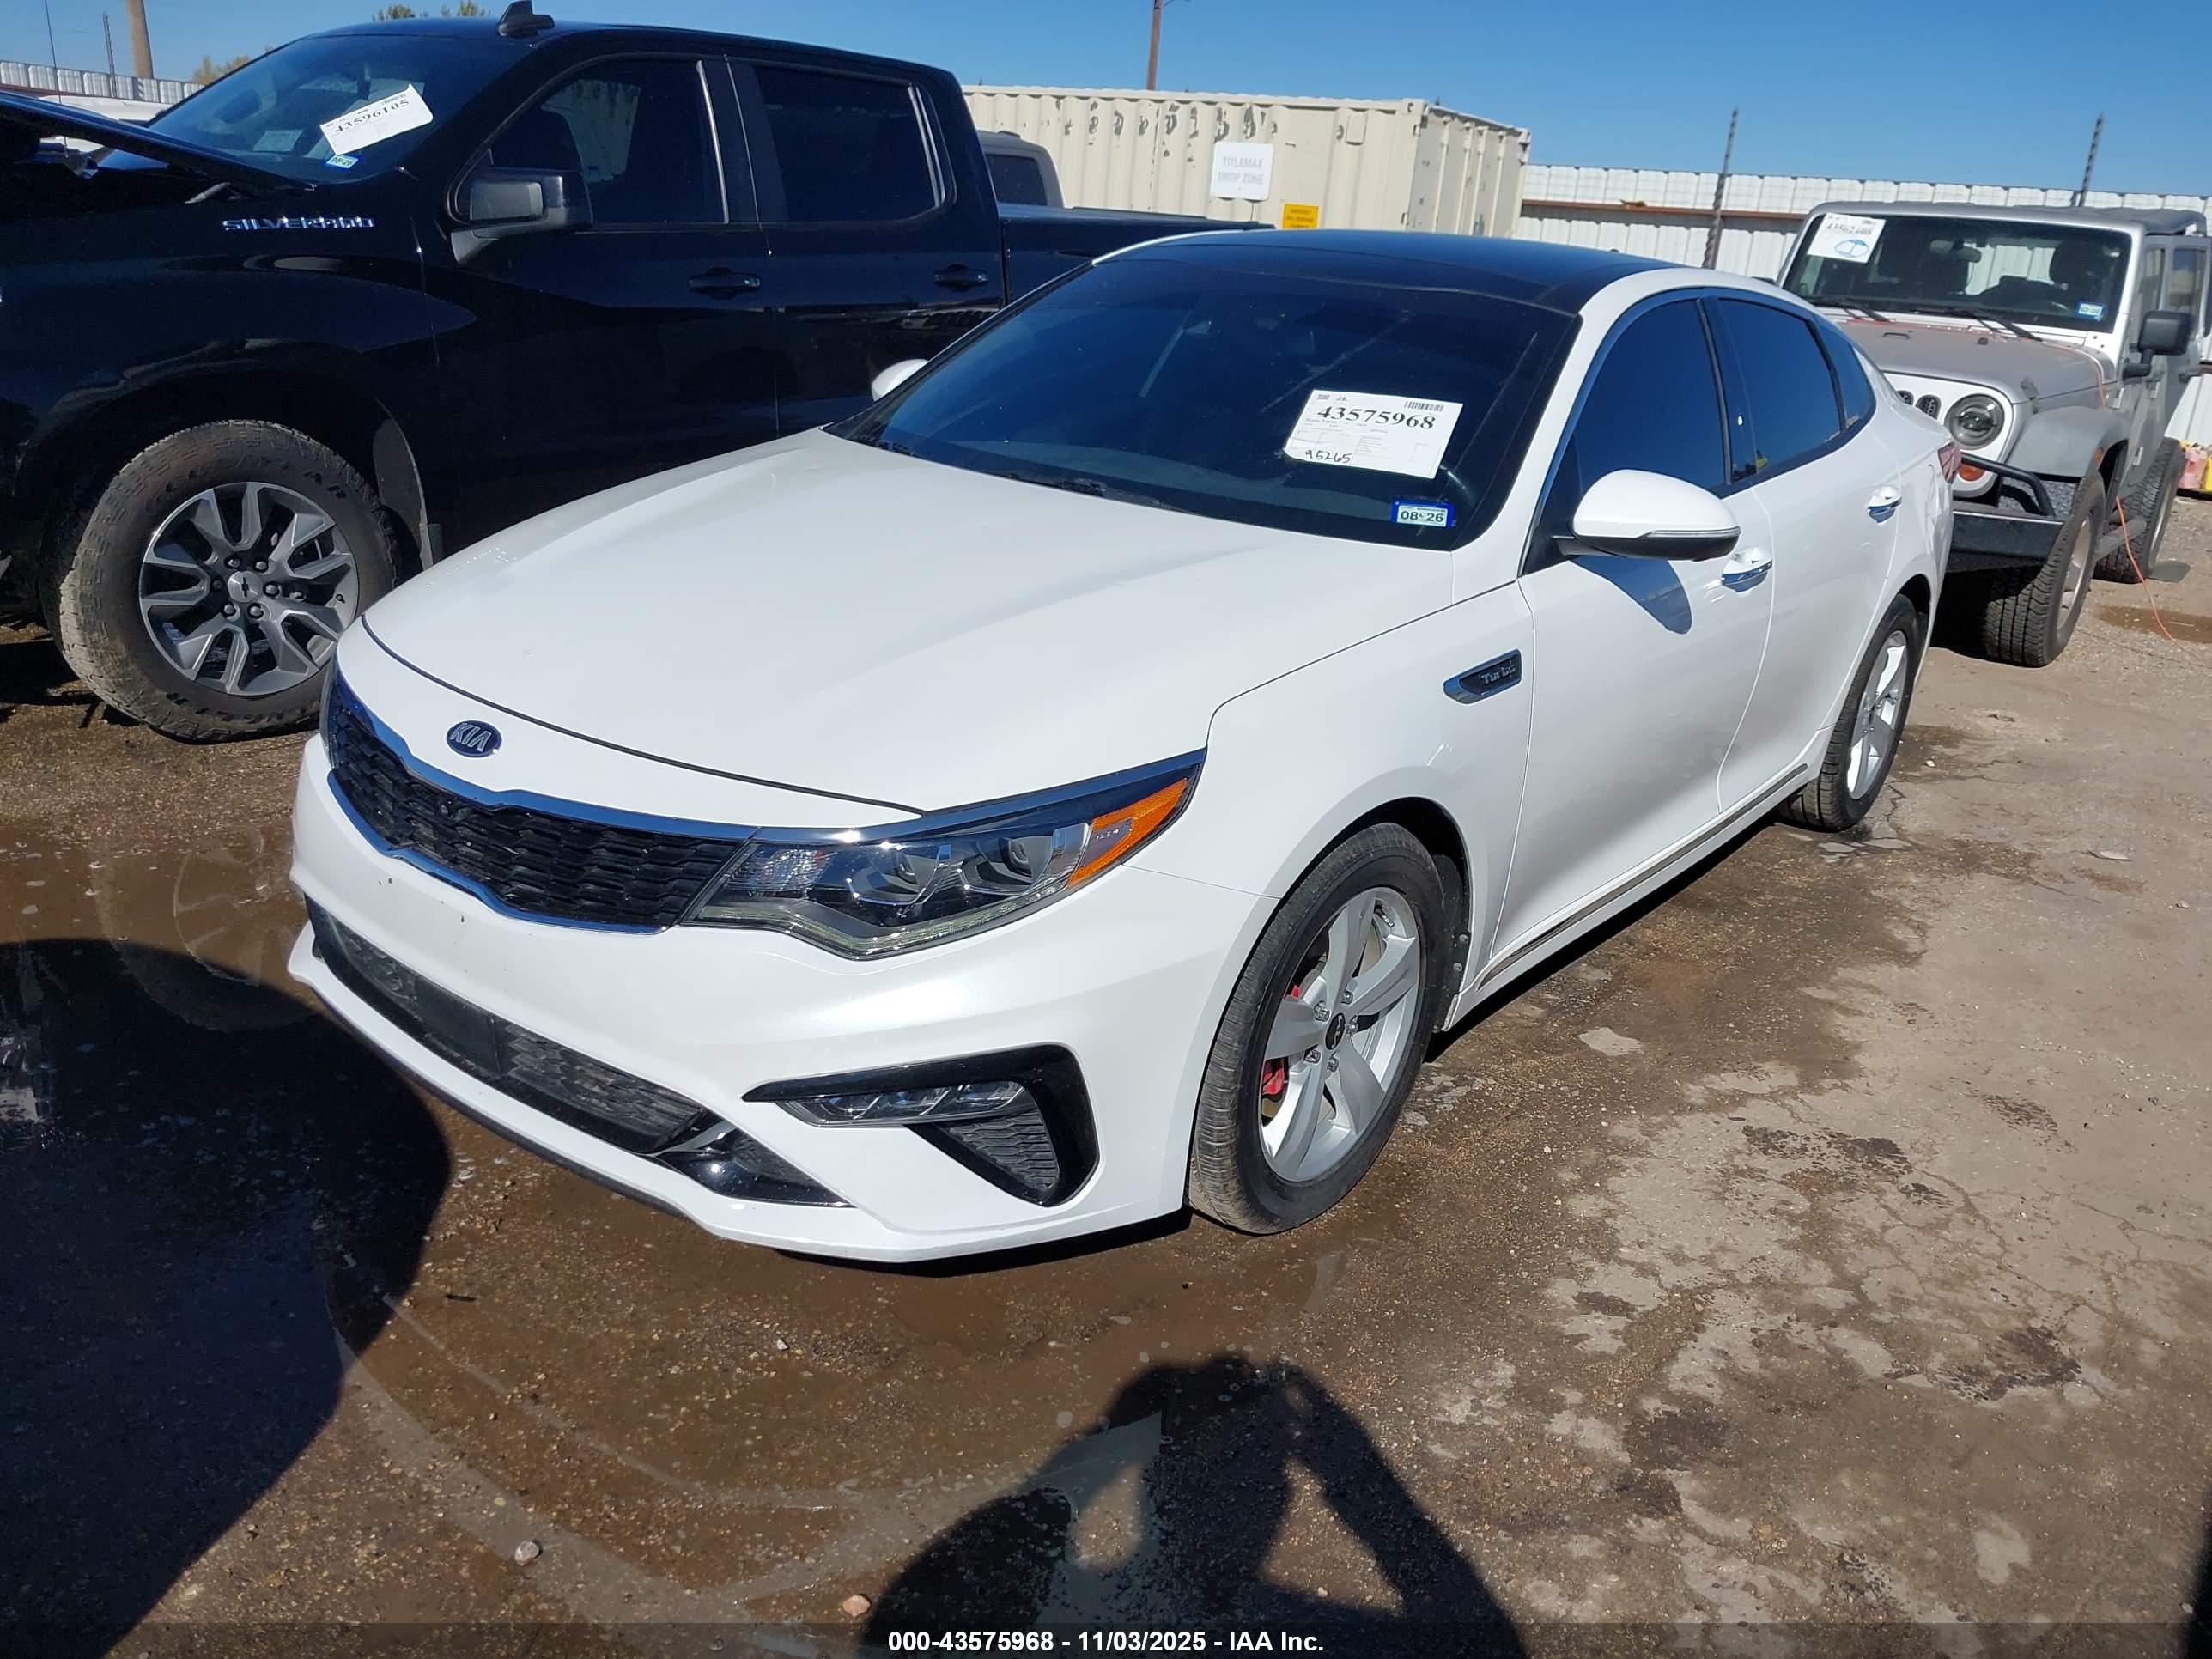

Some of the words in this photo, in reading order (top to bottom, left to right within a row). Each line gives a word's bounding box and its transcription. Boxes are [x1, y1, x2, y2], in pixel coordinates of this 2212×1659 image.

[335, 99, 409, 132] 43596105
[1223, 156, 1263, 168] TITLEMAX
[1218, 172, 1241, 182] DROP
[1243, 173, 1264, 185] ZONE
[1316, 405, 1437, 430] 43575968
[1401, 511, 1418, 520] 08
[1426, 513, 1444, 523] 26
[449, 722, 492, 752] KIA
